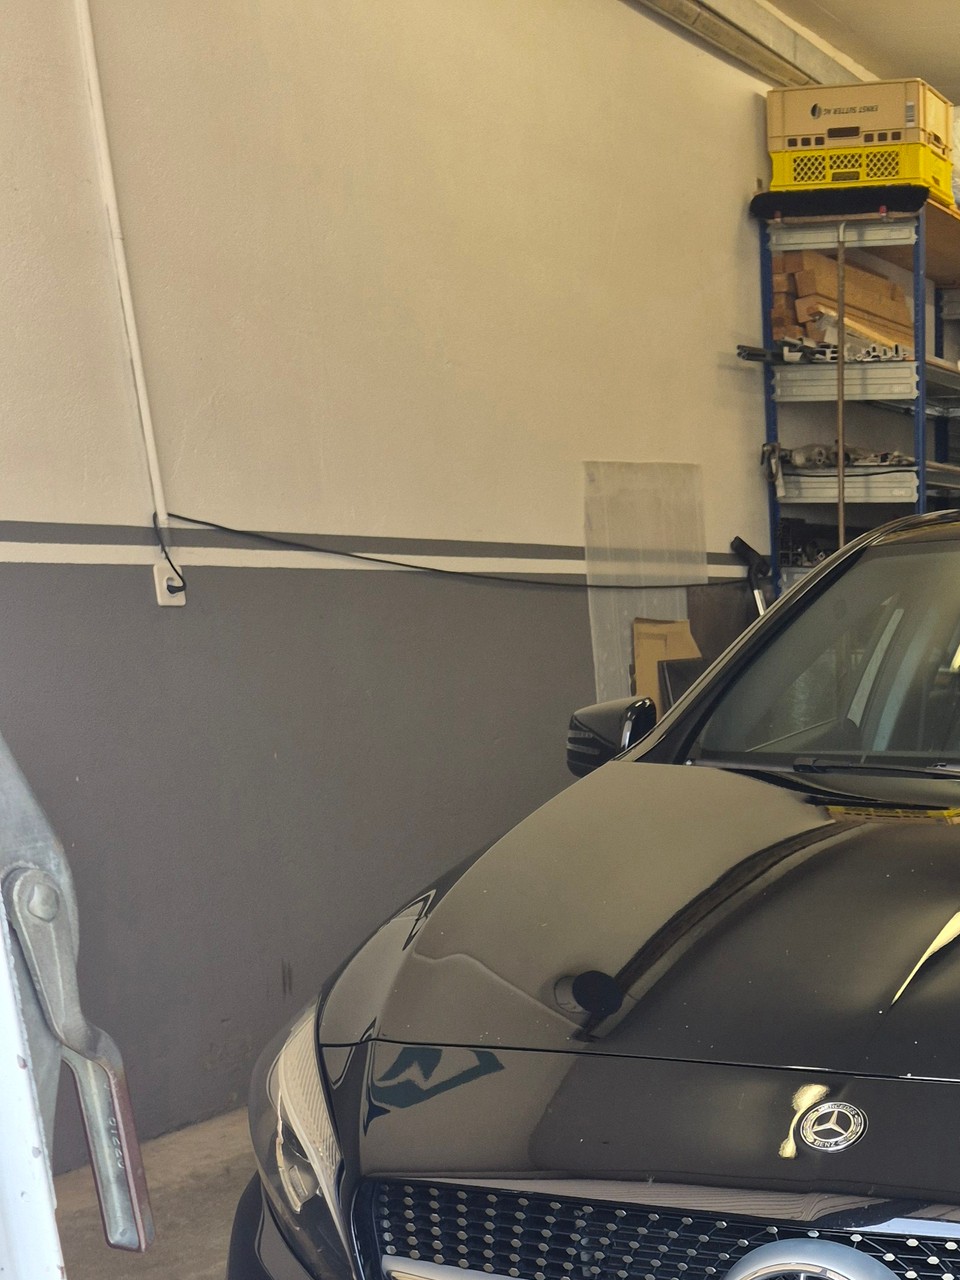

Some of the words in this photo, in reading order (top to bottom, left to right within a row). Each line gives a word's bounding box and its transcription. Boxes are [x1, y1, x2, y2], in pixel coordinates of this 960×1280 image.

[833, 106, 858, 115] SUTTER
[858, 104, 879, 113] ERNST
[817, 1103, 857, 1115] MERCEDES
[813, 1139, 838, 1148] BENZ
